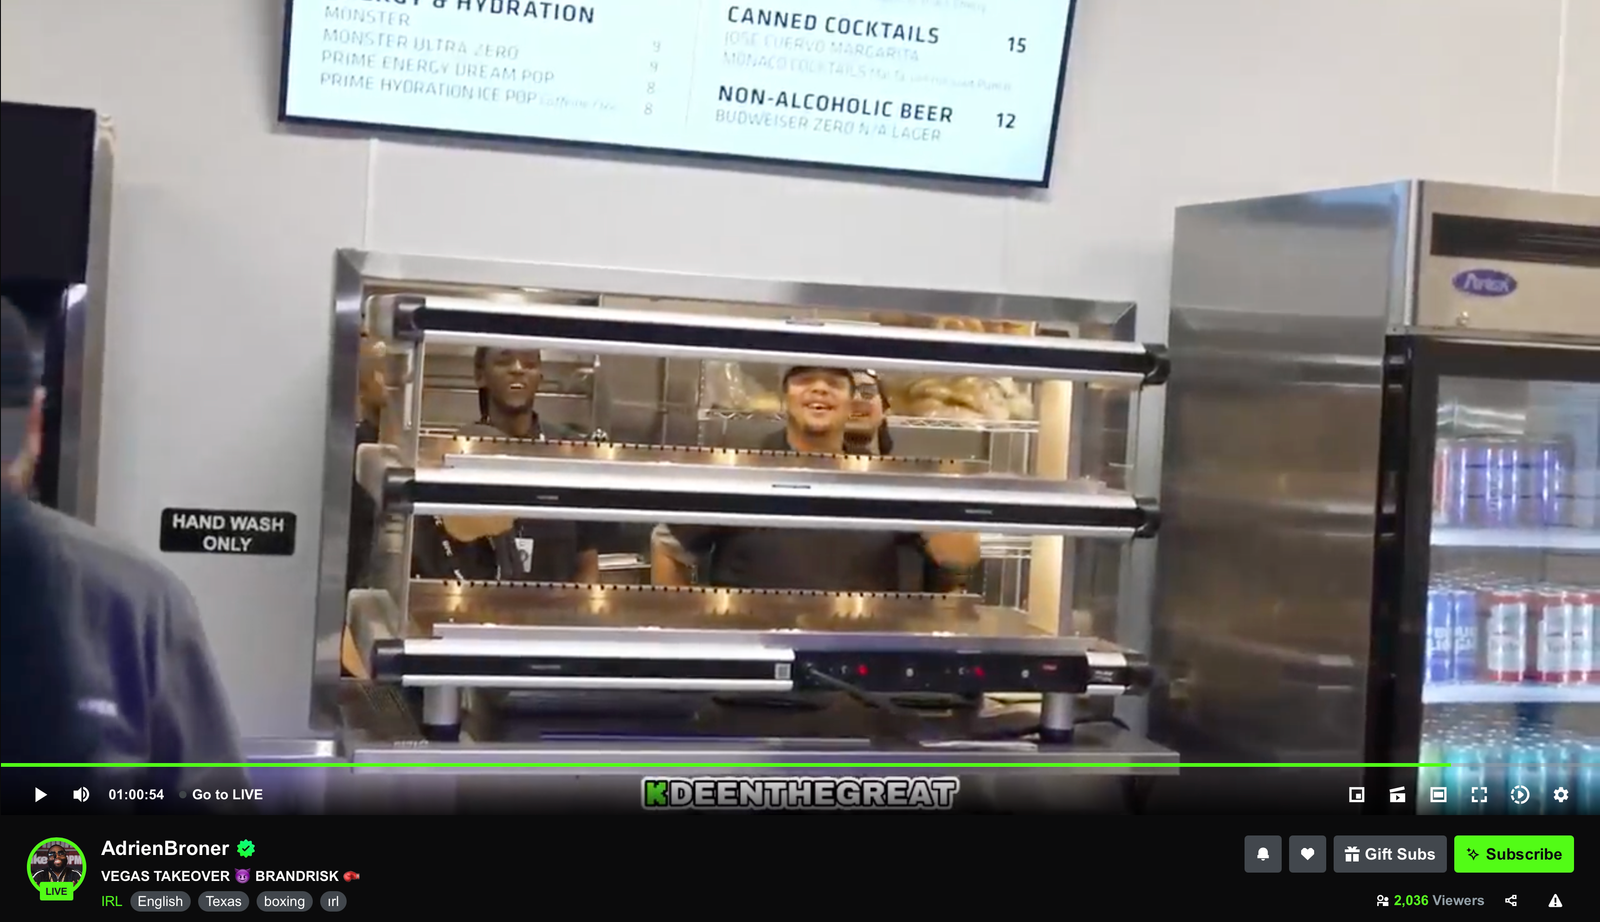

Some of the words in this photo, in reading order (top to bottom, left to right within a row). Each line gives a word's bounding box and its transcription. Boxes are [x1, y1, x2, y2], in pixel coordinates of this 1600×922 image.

[324, 6, 410, 26] MONSTER
[456, 0, 595, 24] HYDRATION
[728, 5, 817, 31] CANNED
[824, 16, 940, 44] COCKTAILS
[322, 28, 408, 49] MONSTER
[413, 37, 468, 54] ULTRA
[474, 43, 519, 60] ZERO
[830, 42, 919, 62] MARGARITA
[1007, 36, 1027, 54] 15
[321, 50, 377, 69] PRIME
[382, 55, 450, 75] ENERGY
[455, 62, 517, 82] DREAM
[521, 69, 555, 84] POP
[649, 61, 659, 73] 9
[320, 72, 375, 91] PRIME
[380, 78, 474, 100] HYDRATION
[477, 85, 500, 103] ICE
[505, 88, 538, 105] POP
[646, 81, 656, 94] 8
[643, 102, 653, 116] 8
[717, 84, 894, 118] NON-ALCOHOLIC
[899, 102, 954, 124] BEER
[715, 109, 809, 131] BUDWEISER
[813, 117, 855, 136] ZERO
[891, 123, 942, 143] LAGER
[995, 112, 1017, 129] 12
[172, 513, 226, 530] HAND
[230, 515, 285, 533] WASH
[202, 535, 253, 552] ONLY
